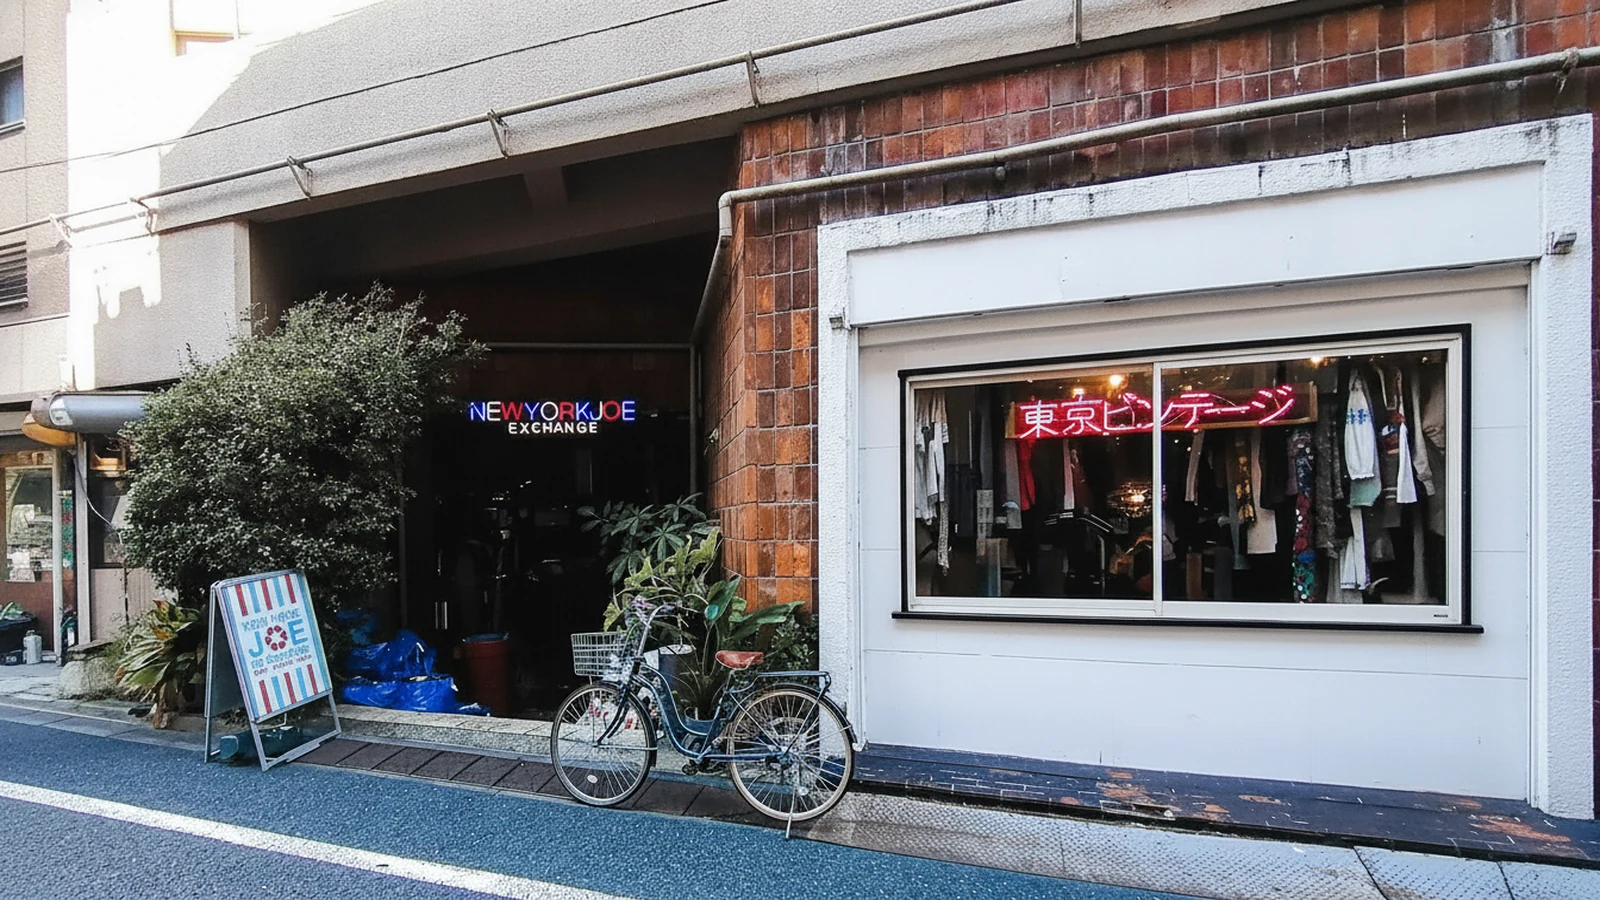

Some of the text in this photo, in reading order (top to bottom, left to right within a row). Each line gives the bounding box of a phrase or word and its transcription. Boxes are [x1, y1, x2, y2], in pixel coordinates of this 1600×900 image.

[508, 421, 598, 435] EXCHANGE
[1019, 384, 1295, 439] 東京ビンテージ
[248, 618, 309, 658] JOE
